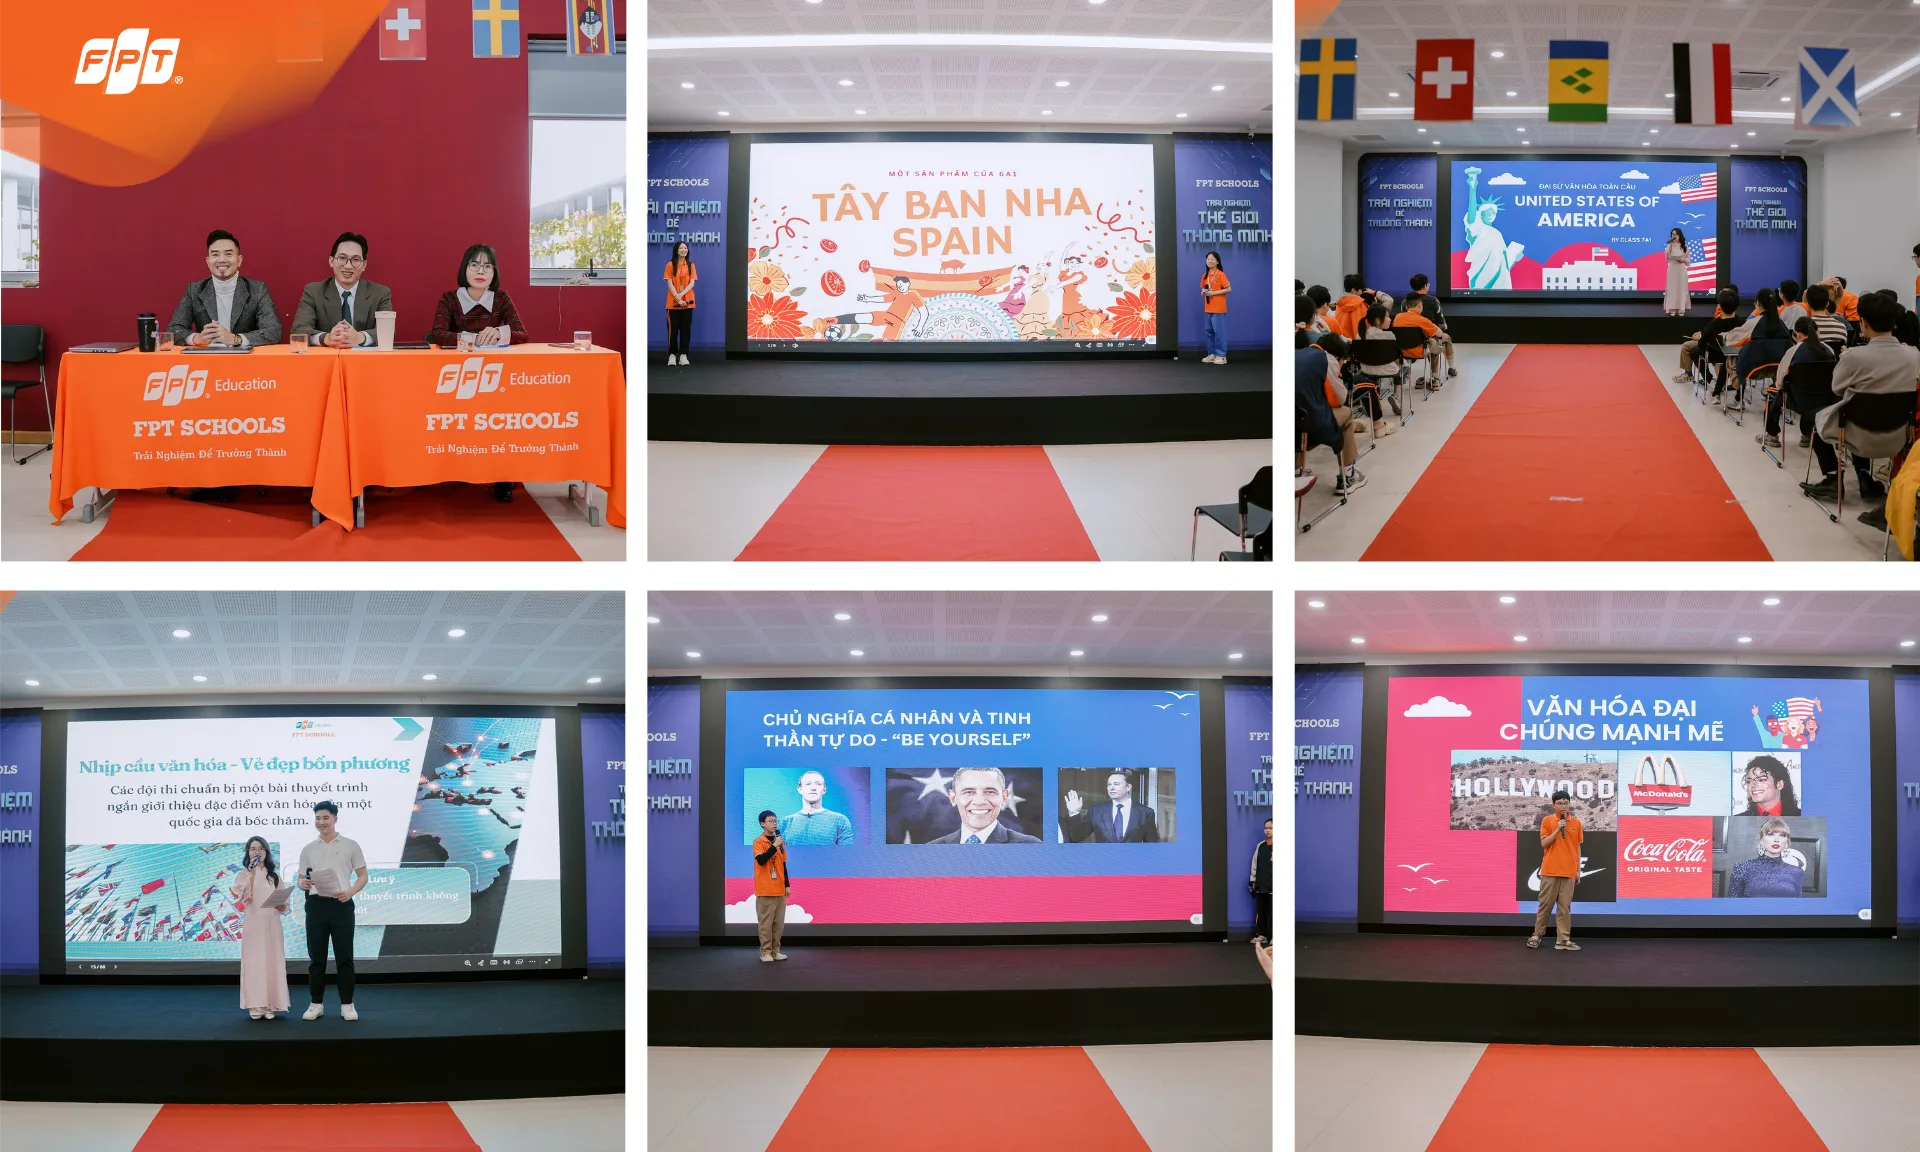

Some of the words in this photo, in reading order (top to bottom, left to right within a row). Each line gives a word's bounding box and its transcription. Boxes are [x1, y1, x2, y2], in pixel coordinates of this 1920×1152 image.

[888, 169, 910, 178] MỘT
[663, 178, 709, 187] SCHOOLS
[1195, 179, 1214, 188] FPT
[1215, 179, 1260, 188] SCHOOLS
[1539, 183, 1551, 191] ĐẠI
[1582, 182, 1597, 190] HÓA
[1599, 182, 1619, 190] TOÀN
[664, 198, 721, 216] NGHIỆM
[812, 183, 890, 222] TÂY
[905, 189, 986, 220] BAN
[1005, 187, 1093, 217] NHA
[1223, 198, 1251, 208] NGHIỆM
[1368, 196, 1390, 208] TRẢI
[1393, 197, 1432, 209] NGHIỆM
[1514, 195, 1576, 207] UNITED
[1576, 195, 1635, 207] STATES
[1638, 195, 1661, 208] OF
[1198, 207, 1226, 224] THẾ
[1745, 204, 1765, 217] THẾ
[1403, 217, 1433, 227] THÀNH
[1537, 212, 1636, 228] AMERICA
[1771, 219, 1797, 229] MINH
[679, 229, 721, 243] THÀNH
[893, 225, 1013, 258] SPAIN
[1182, 227, 1233, 243] THÔNG
[143, 364, 209, 406] FPT
[215, 377, 277, 391] Education
[435, 356, 504, 399] FPT
[510, 371, 571, 385] Education
[133, 420, 175, 438] FPT
[180, 416, 286, 436] SCHOOLS
[425, 413, 468, 431] FPT
[474, 411, 579, 431] SCHOOLS
[133, 449, 153, 460] Trải
[156, 450, 195, 461] Nghiệm
[199, 447, 213, 459] Để
[216, 448, 252, 459] Trưởng
[255, 447, 287, 457] Thành
[425, 443, 445, 454] Trải
[447, 443, 488, 456] Nghiệm
[491, 442, 506, 454] Để
[508, 443, 546, 454] Trưởng
[549, 442, 579, 453] Thành
[1527, 694, 1582, 716] VĂN
[1590, 693, 1647, 717] HÓA
[1653, 699, 1697, 721] ĐẠI
[763, 709, 802, 726] CHỦ
[807, 709, 867, 725] NGHĨA
[870, 709, 896, 725] CÁ
[900, 709, 954, 725] NHÂN
[958, 709, 983, 725] VÀ
[987, 712, 1031, 725] TINH
[763, 728, 813, 747] THẦN
[818, 733, 845, 750] TỰ
[850, 733, 877, 747] DO
[892, 733, 925, 746] “BE
[928, 733, 1031, 746] YOURSELF”
[1249, 732, 1270, 741] FPT
[1499, 718, 1596, 741] CHÚNG
[1602, 723, 1681, 745] MẠNH
[1688, 720, 1724, 742] MẼ
[79, 759, 122, 777] Nhịp
[124, 757, 155, 773] cầu
[158, 759, 191, 772] văn
[194, 757, 227, 772] hóa
[240, 757, 264, 771] Vẻ
[266, 756, 300, 774] đẹp
[303, 755, 338, 770] bốn
[340, 756, 411, 774] phương
[110, 784, 134, 796] Các
[137, 784, 157, 797] đội
[160, 784, 178, 795] thi
[180, 783, 220, 794] chuẩn
[224, 783, 236, 795] bị
[239, 782, 265, 795] một
[268, 782, 288, 793] bài
[291, 781, 333, 794] thuyết
[336, 781, 369, 792] trình
[1303, 779, 1353, 795] THÀNH
[1455, 777, 1615, 799] HOLLYWOOD
[1633, 790, 1689, 799] McDonald's
[107, 800, 138, 814] ngắn
[141, 800, 165, 813] giới
[168, 800, 201, 812] thiệu
[204, 799, 228, 812] đặc
[230, 798, 263, 810] điểm
[266, 799, 290, 809] văn
[293, 798, 315, 809] hóa
[347, 798, 373, 811] một
[169, 815, 201, 830] quốc
[203, 816, 223, 829] gia
[226, 815, 242, 826] đã
[245, 815, 269, 826] bốc
[272, 815, 309, 826] thăm.
[1623, 838, 1710, 863] Coca-Cola
[388, 874, 396, 884] ý
[360, 891, 393, 902] thuyết
[396, 891, 422, 900] trình
[426, 890, 459, 901] không
